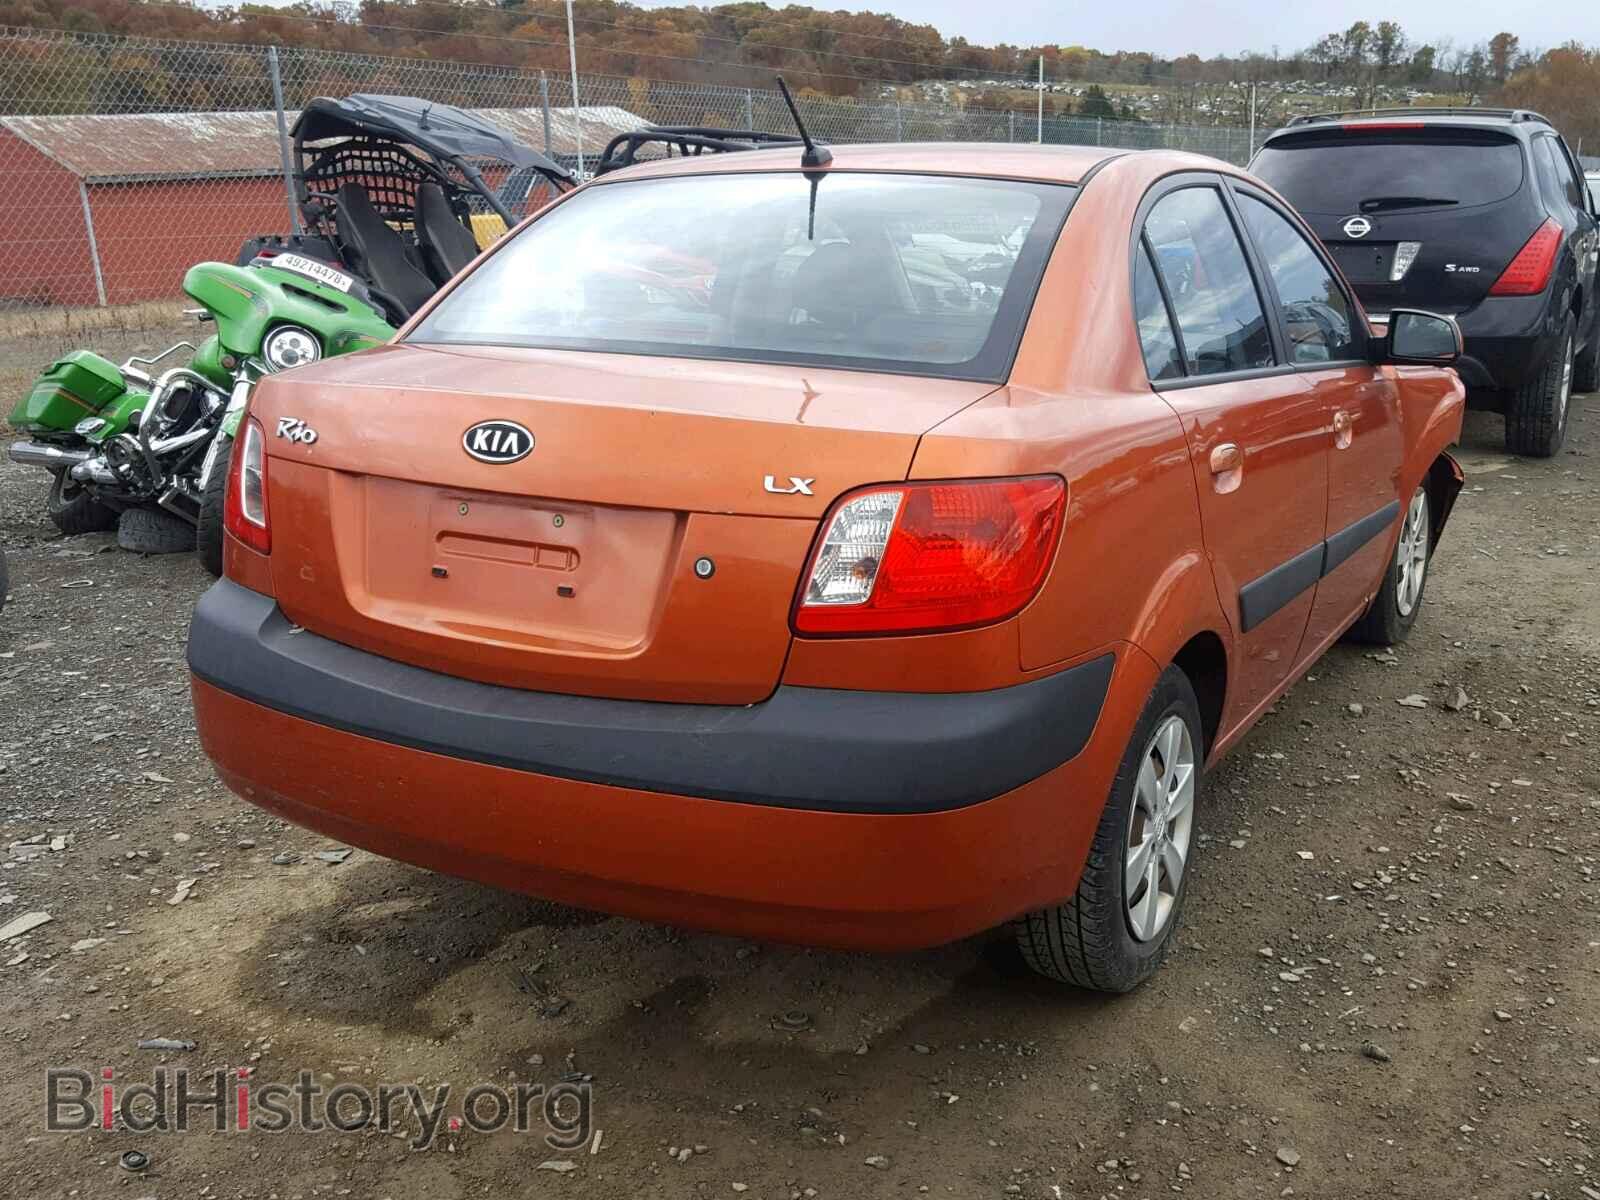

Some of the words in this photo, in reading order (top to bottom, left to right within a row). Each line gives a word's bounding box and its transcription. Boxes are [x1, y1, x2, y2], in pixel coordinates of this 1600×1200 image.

[1444, 263, 1457, 273] S
[276, 416, 318, 444] Rio
[473, 428, 519, 454] KIA
[764, 475, 816, 495] LX
